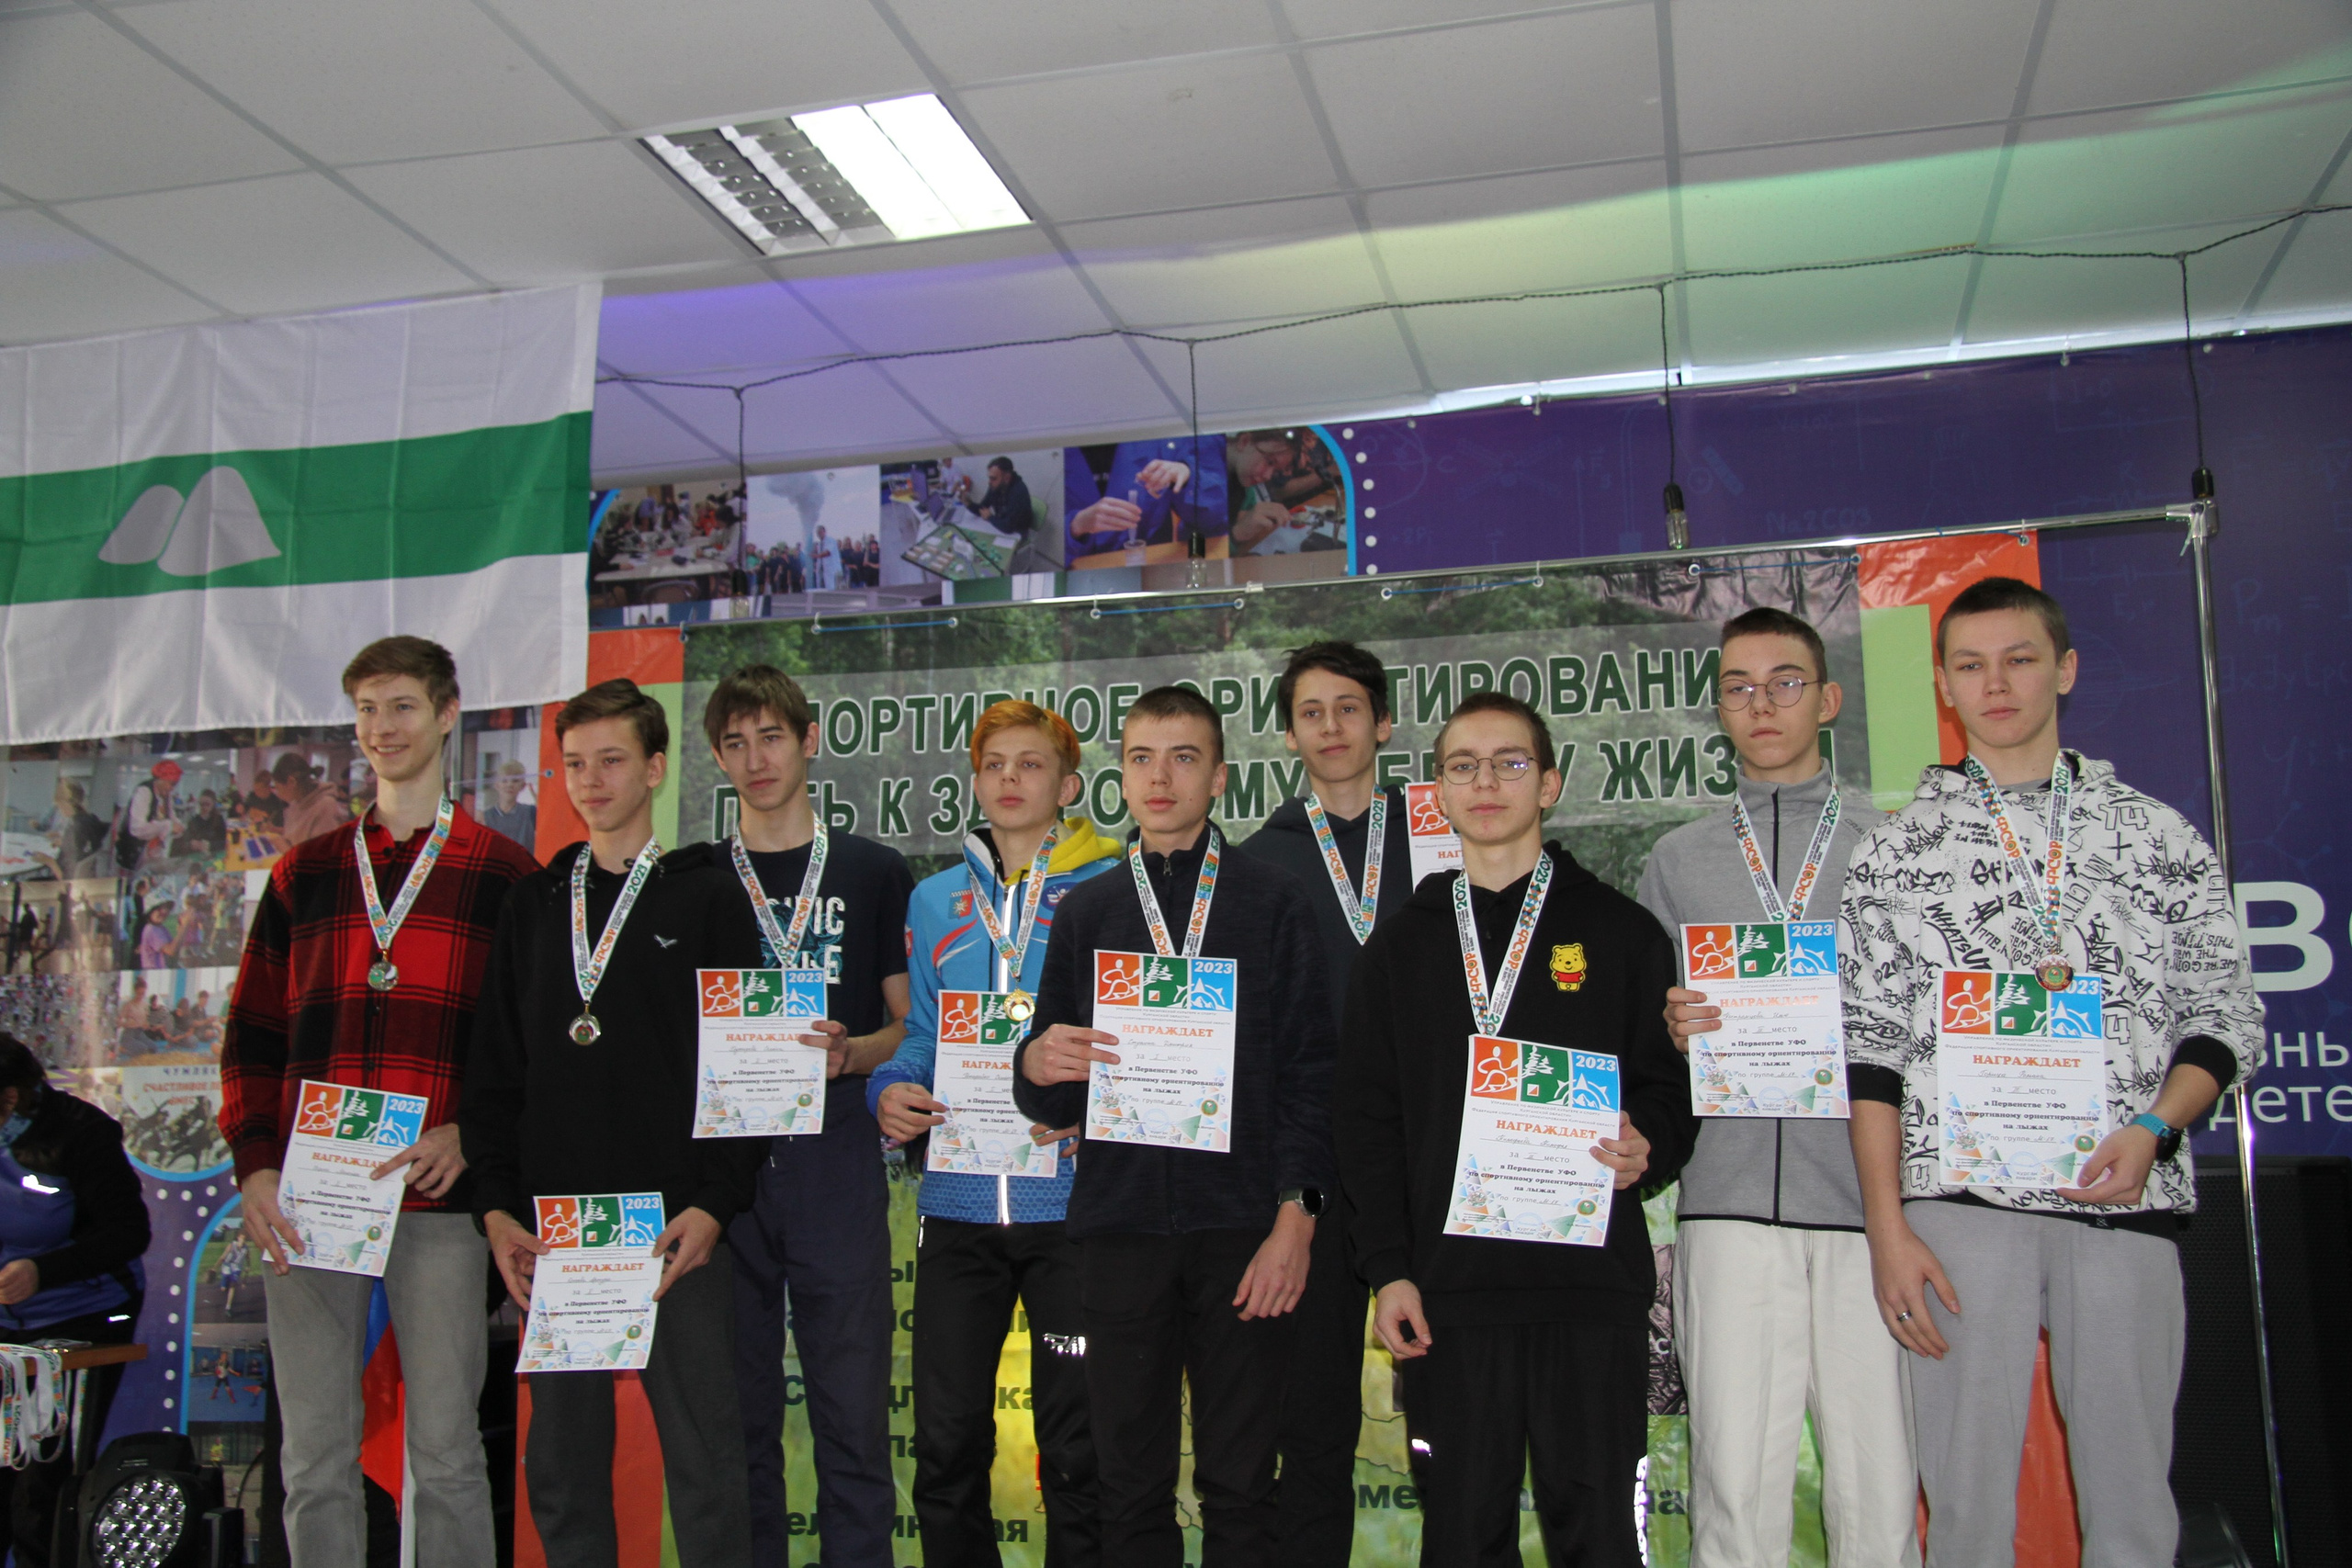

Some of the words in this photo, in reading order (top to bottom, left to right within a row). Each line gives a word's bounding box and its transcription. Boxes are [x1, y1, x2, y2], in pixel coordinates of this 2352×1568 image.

[877, 777, 913, 837] К
[1599, 729, 1835, 805] ЖИЗ
[1792, 924, 1834, 937] 2023
[1194, 962, 1233, 975] 2023
[788, 972, 823, 983] 2023
[2062, 979, 2099, 995] 023
[1720, 995, 1819, 1008] НАГРАЖДАЕТ
[1122, 1024, 1214, 1038] НАГРАЖДАЕТ
[1713, 1050, 1766, 1058] спортивному
[1576, 1055, 1616, 1072] 2023
[1973, 1055, 2081, 1067] НАГРАЖДАЕТ
[1135, 1066, 1178, 1075] Первенстве
[1112, 1075, 1159, 1085] спортивному
[1160, 1078, 1225, 1088] ориентированию
[389, 1099, 424, 1114] 2023
[1991, 1100, 2041, 1109] Первенстве
[1964, 1111, 2021, 1121] спортивному
[2023, 1113, 2099, 1122] ориентированию
[1496, 1119, 1598, 1139] НАГРАЖДАЕТ
[1544, 1154, 1570, 1164] место
[1507, 1164, 1555, 1175] Первенстве
[1557, 1168, 1577, 1177] УФО
[1480, 1172, 1533, 1184] спортивному
[1535, 1178, 1606, 1190] ориентированию
[625, 1197, 660, 1210] 2023
[1512, 1196, 1537, 1204] группе
[561, 1262, 645, 1273] НАГРАЖДАЕТ
